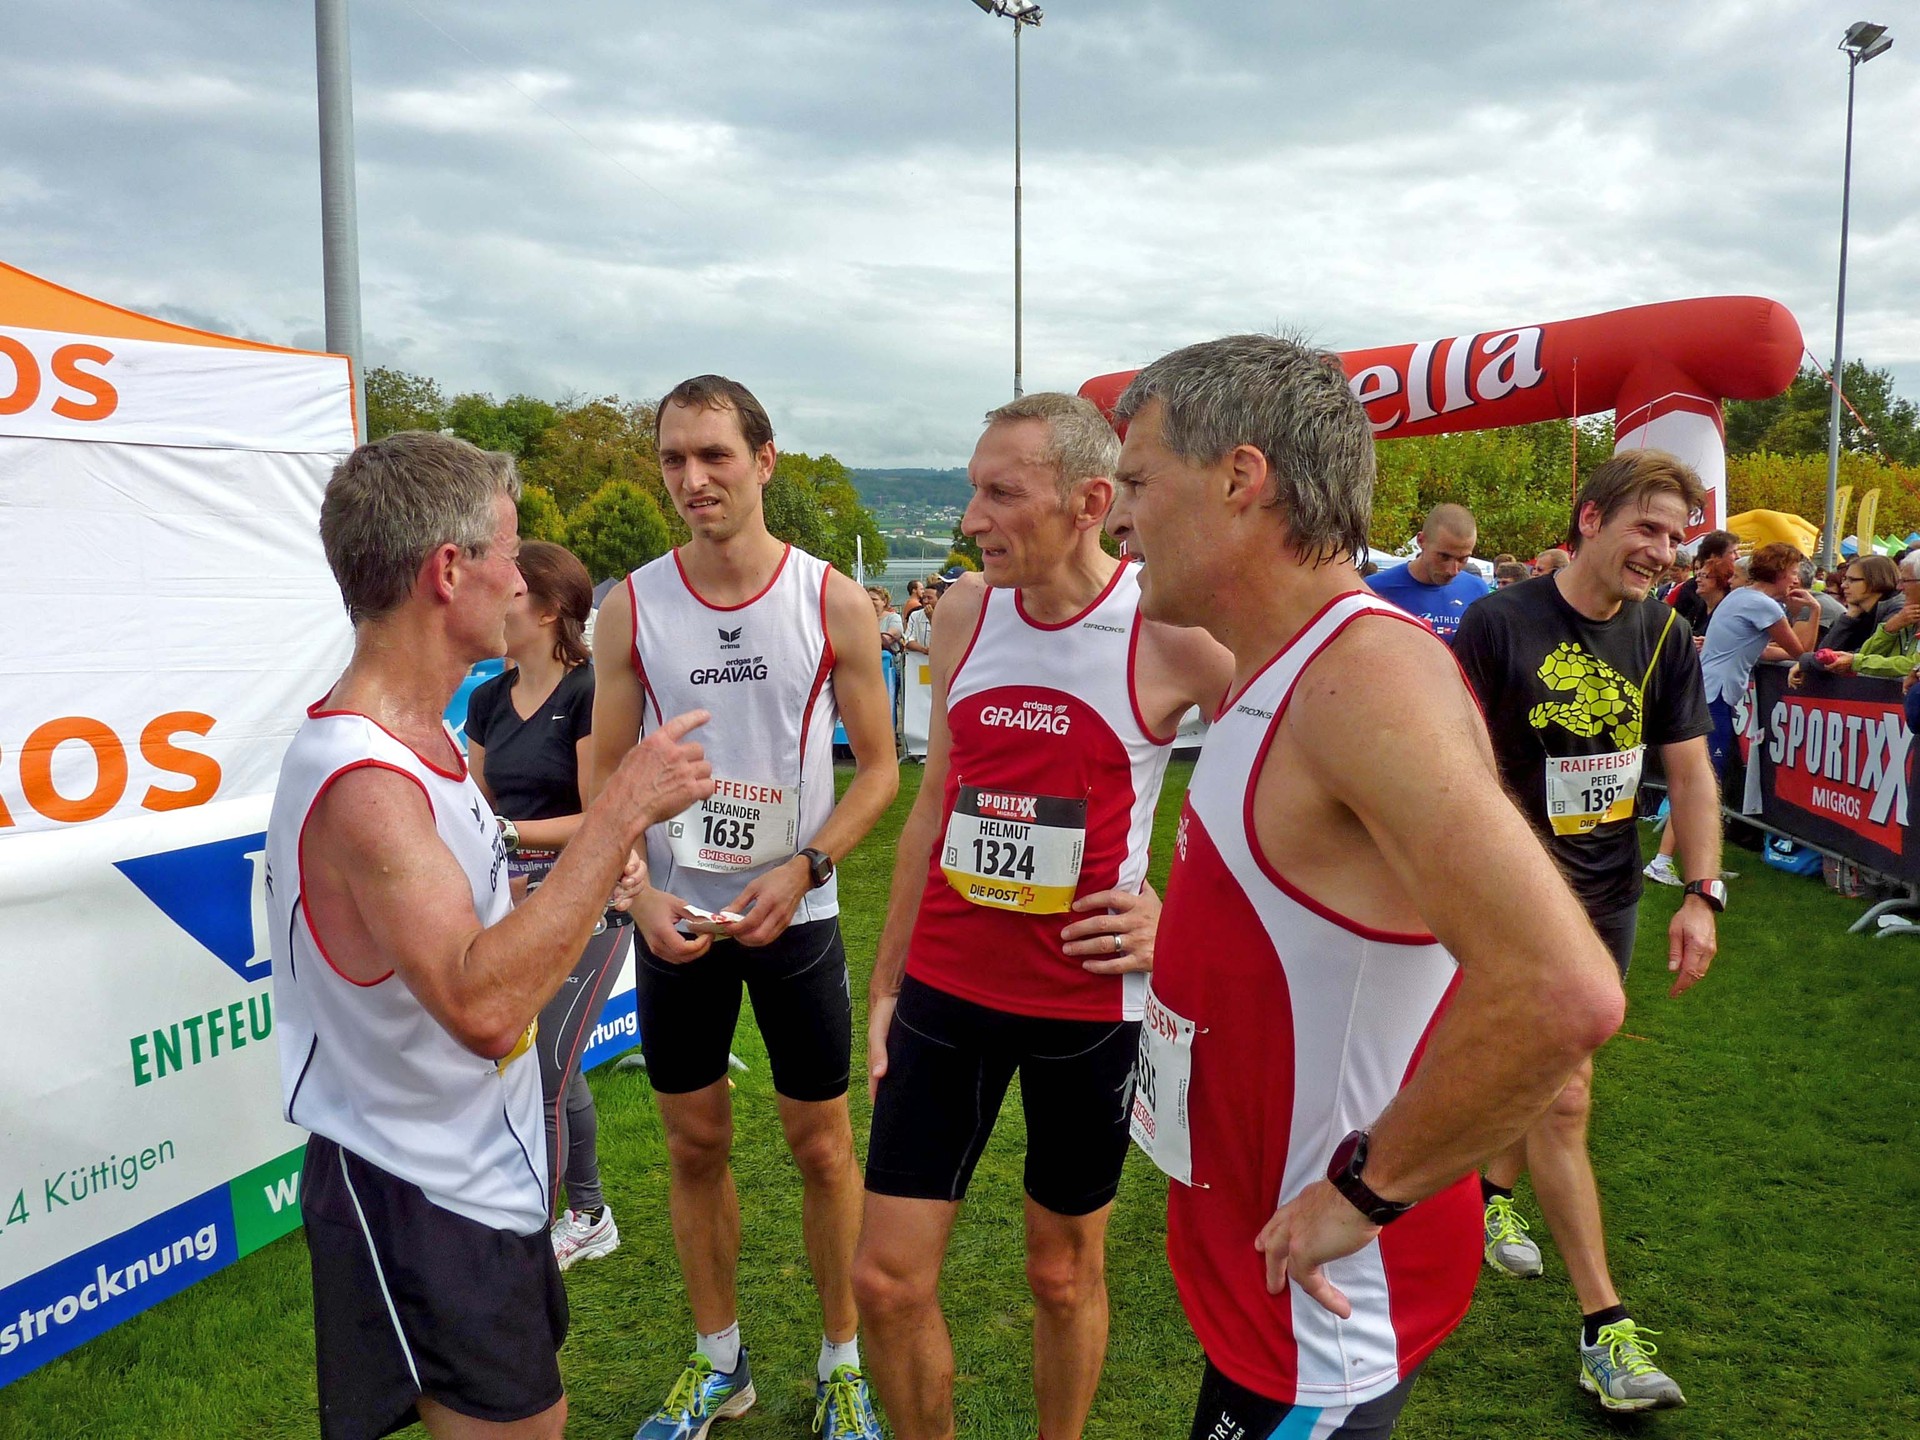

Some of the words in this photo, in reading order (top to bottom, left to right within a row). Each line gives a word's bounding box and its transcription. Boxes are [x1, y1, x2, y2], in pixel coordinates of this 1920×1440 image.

[1348, 327, 1544, 432] ella
[1083, 622, 1126, 633] BROOKS
[725, 657, 751, 666] erdgas
[690, 664, 768, 685] GRAVAG
[1023, 701, 1053, 712] erdgas
[1236, 704, 1274, 719] BROOKS
[980, 706, 1071, 735] GRAVAG
[0, 710, 222, 827] OS
[1560, 750, 1636, 773] RAIFFEISEN
[1769, 701, 1914, 827] SPORTXX
[1591, 774, 1617, 786] PETER
[701, 800, 760, 821] ALEXANDER
[977, 793, 1037, 818] SPORTXX
[1812, 786, 1861, 821] MIGROS
[703, 815, 756, 851] 1635
[979, 820, 1031, 841] HELMUT
[1580, 820, 1594, 828] DIE
[699, 849, 752, 865] SWISSLOS
[973, 838, 1035, 880] 1324
[970, 883, 985, 896] DIE
[987, 887, 1019, 902] POST
[45, 1140, 175, 1213] Küttigen
[0, 1223, 218, 1355] strocknung
